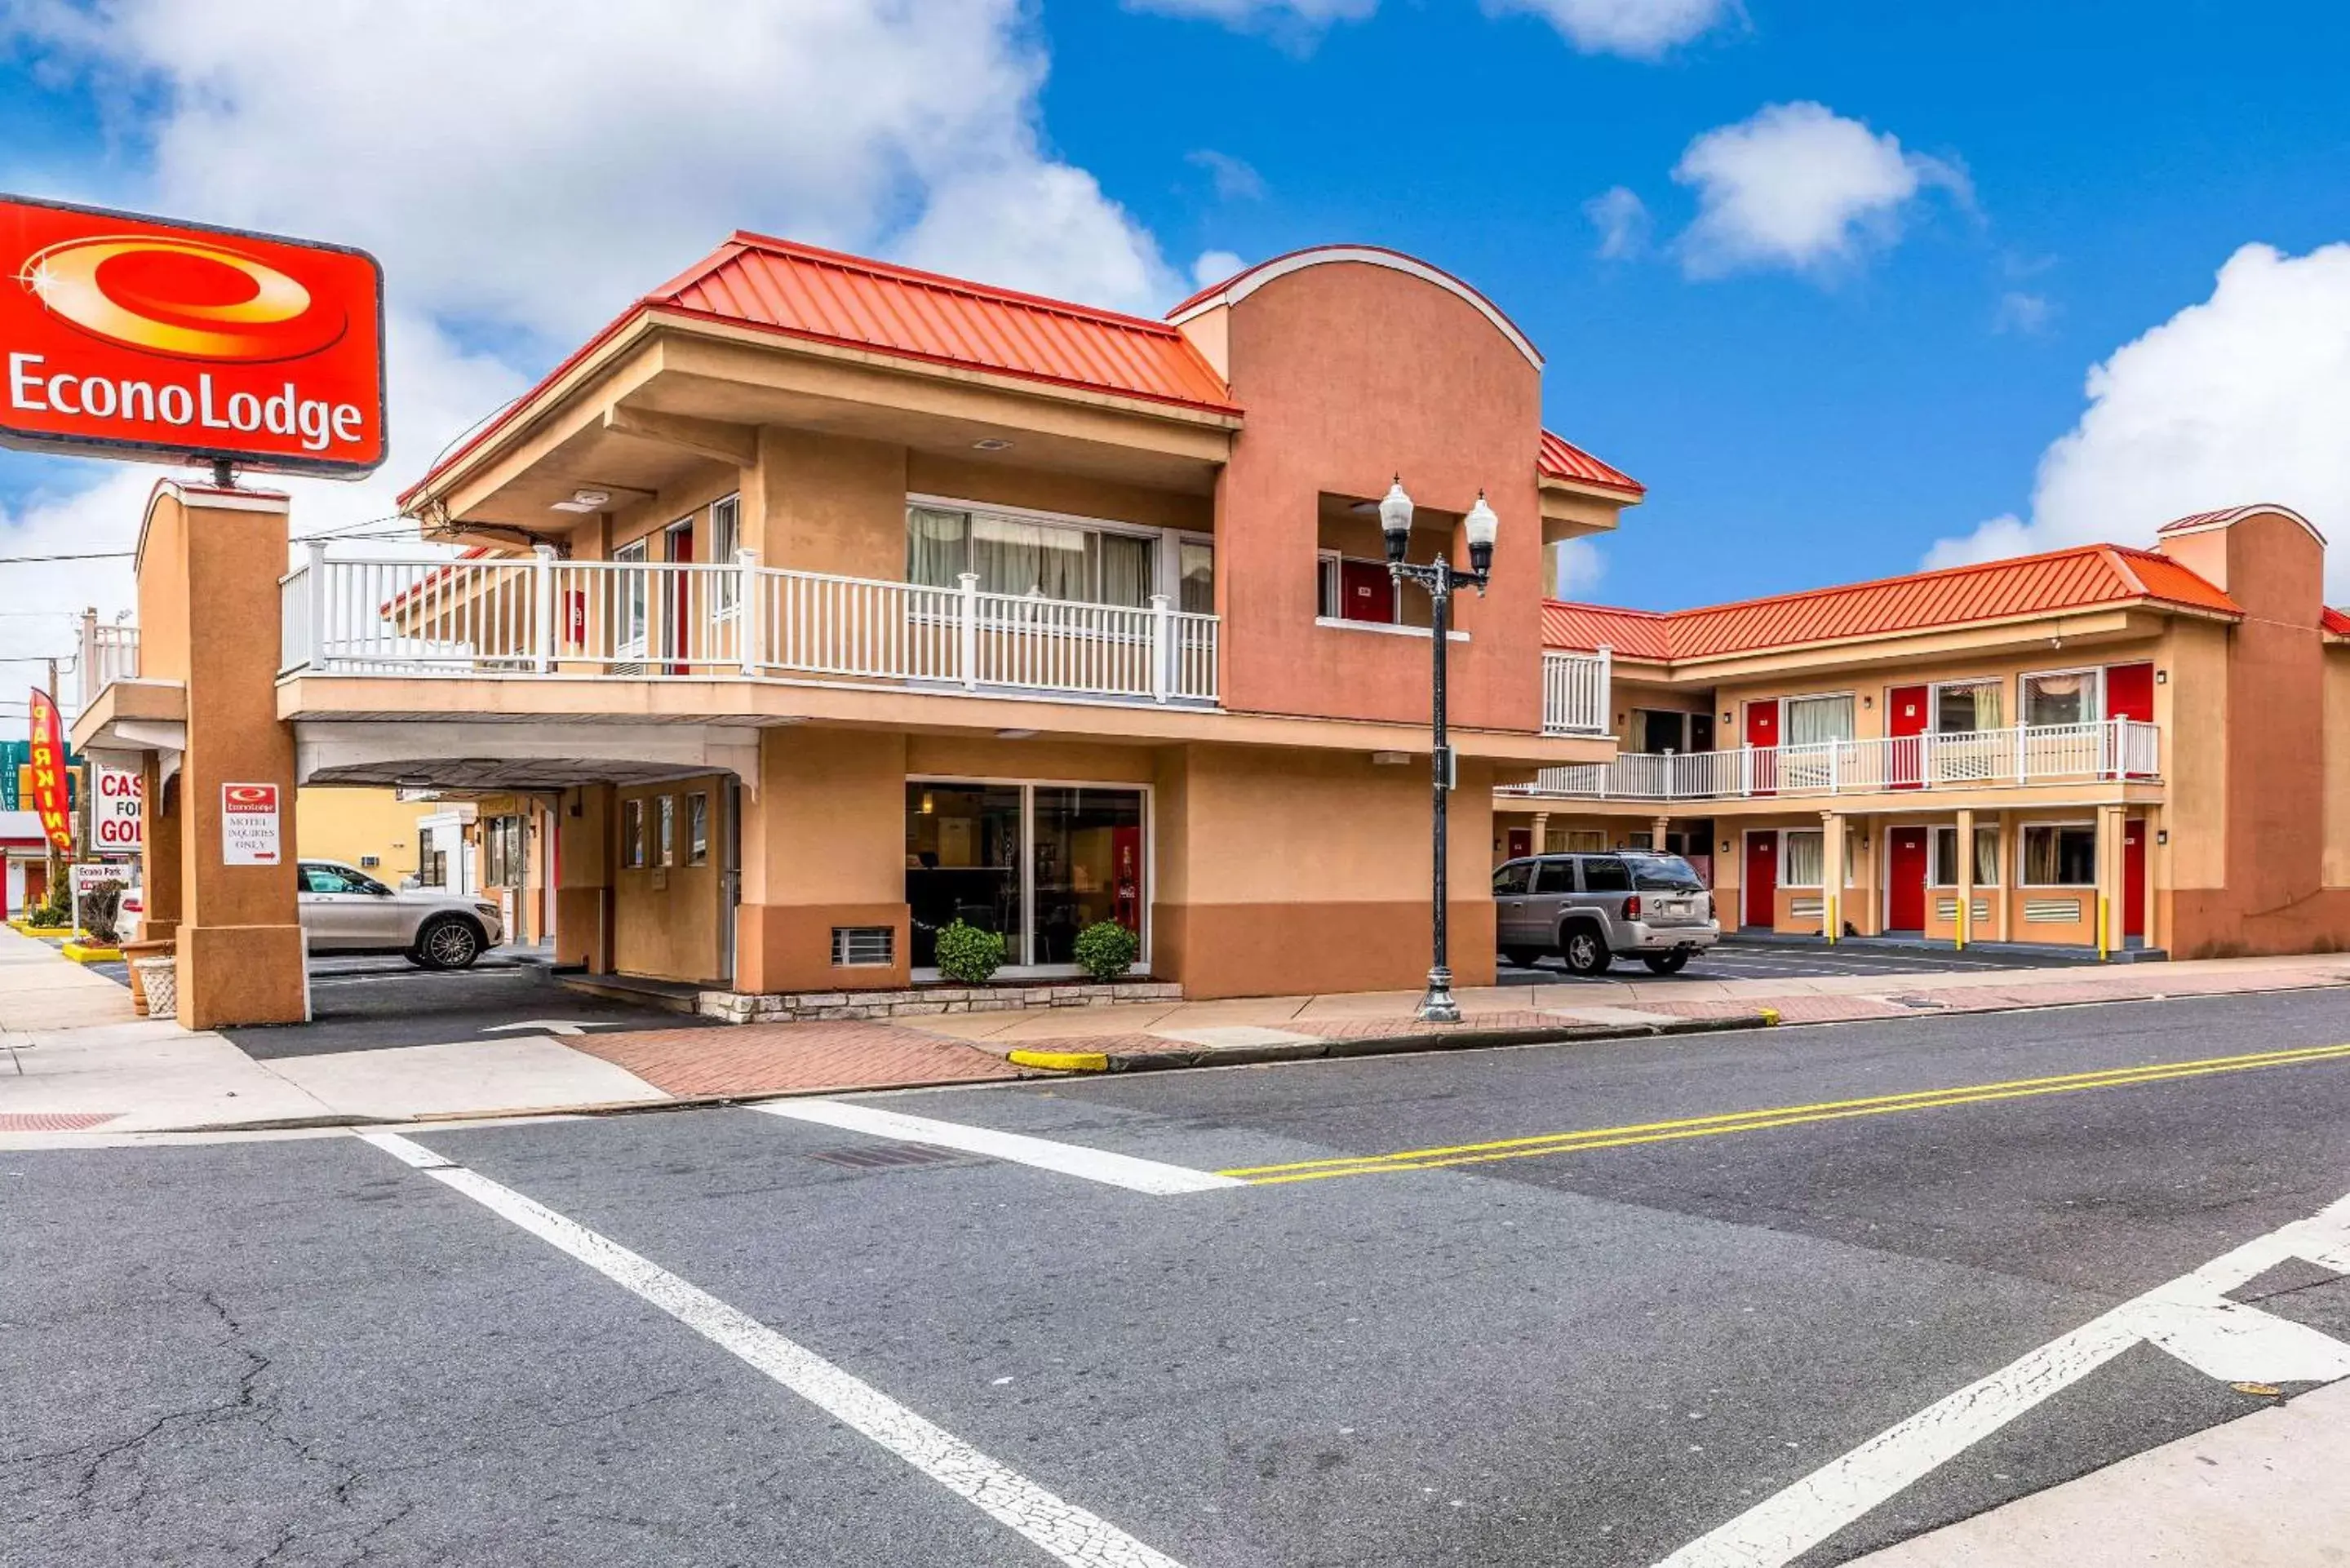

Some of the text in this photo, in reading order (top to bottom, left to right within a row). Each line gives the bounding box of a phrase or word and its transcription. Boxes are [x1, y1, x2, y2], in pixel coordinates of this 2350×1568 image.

[9, 351, 363, 451] EconoLodge
[101, 775, 142, 796] CAS
[101, 820, 142, 842] GOL
